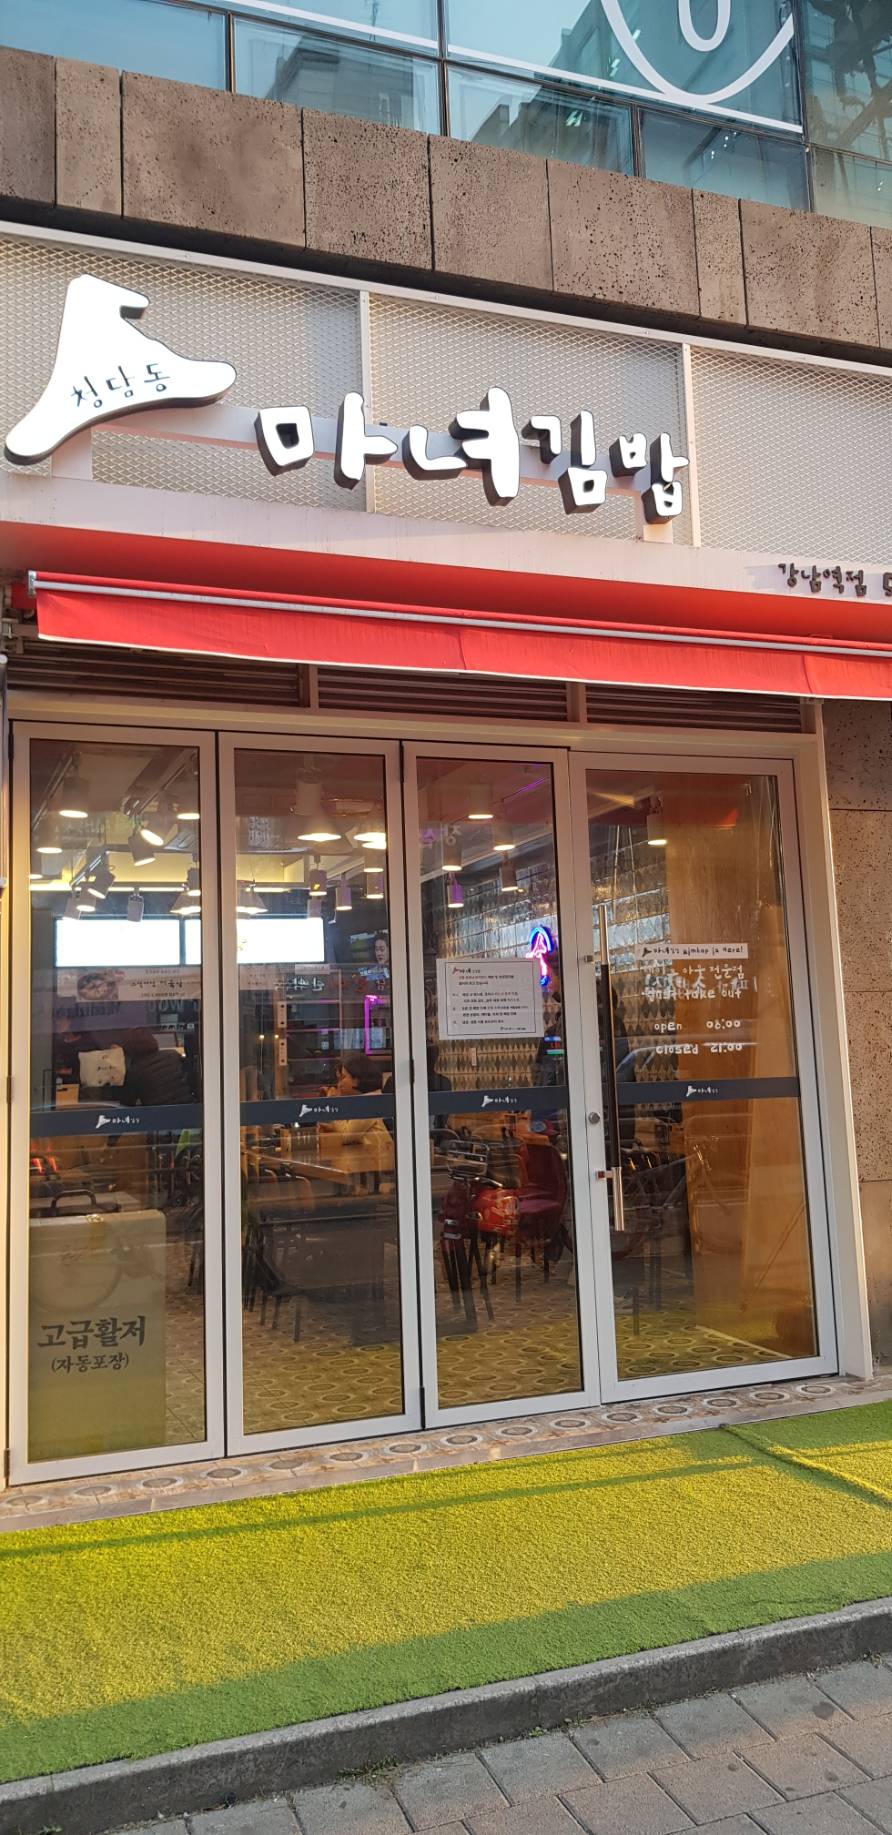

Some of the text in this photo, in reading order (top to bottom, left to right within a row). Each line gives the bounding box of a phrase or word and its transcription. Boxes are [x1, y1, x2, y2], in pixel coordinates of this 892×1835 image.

[70, 363, 171, 408] 청담동
[254, 386, 690, 524] 마녀김밥
[778, 562, 867, 597] 강남역점
[684, 988, 716, 1001] take
[721, 988, 742, 999] out
[654, 1018, 742, 1033] open 06:00
[655, 1043, 699, 1055] closed
[51, 1352, 129, 1374] (자동포장)
